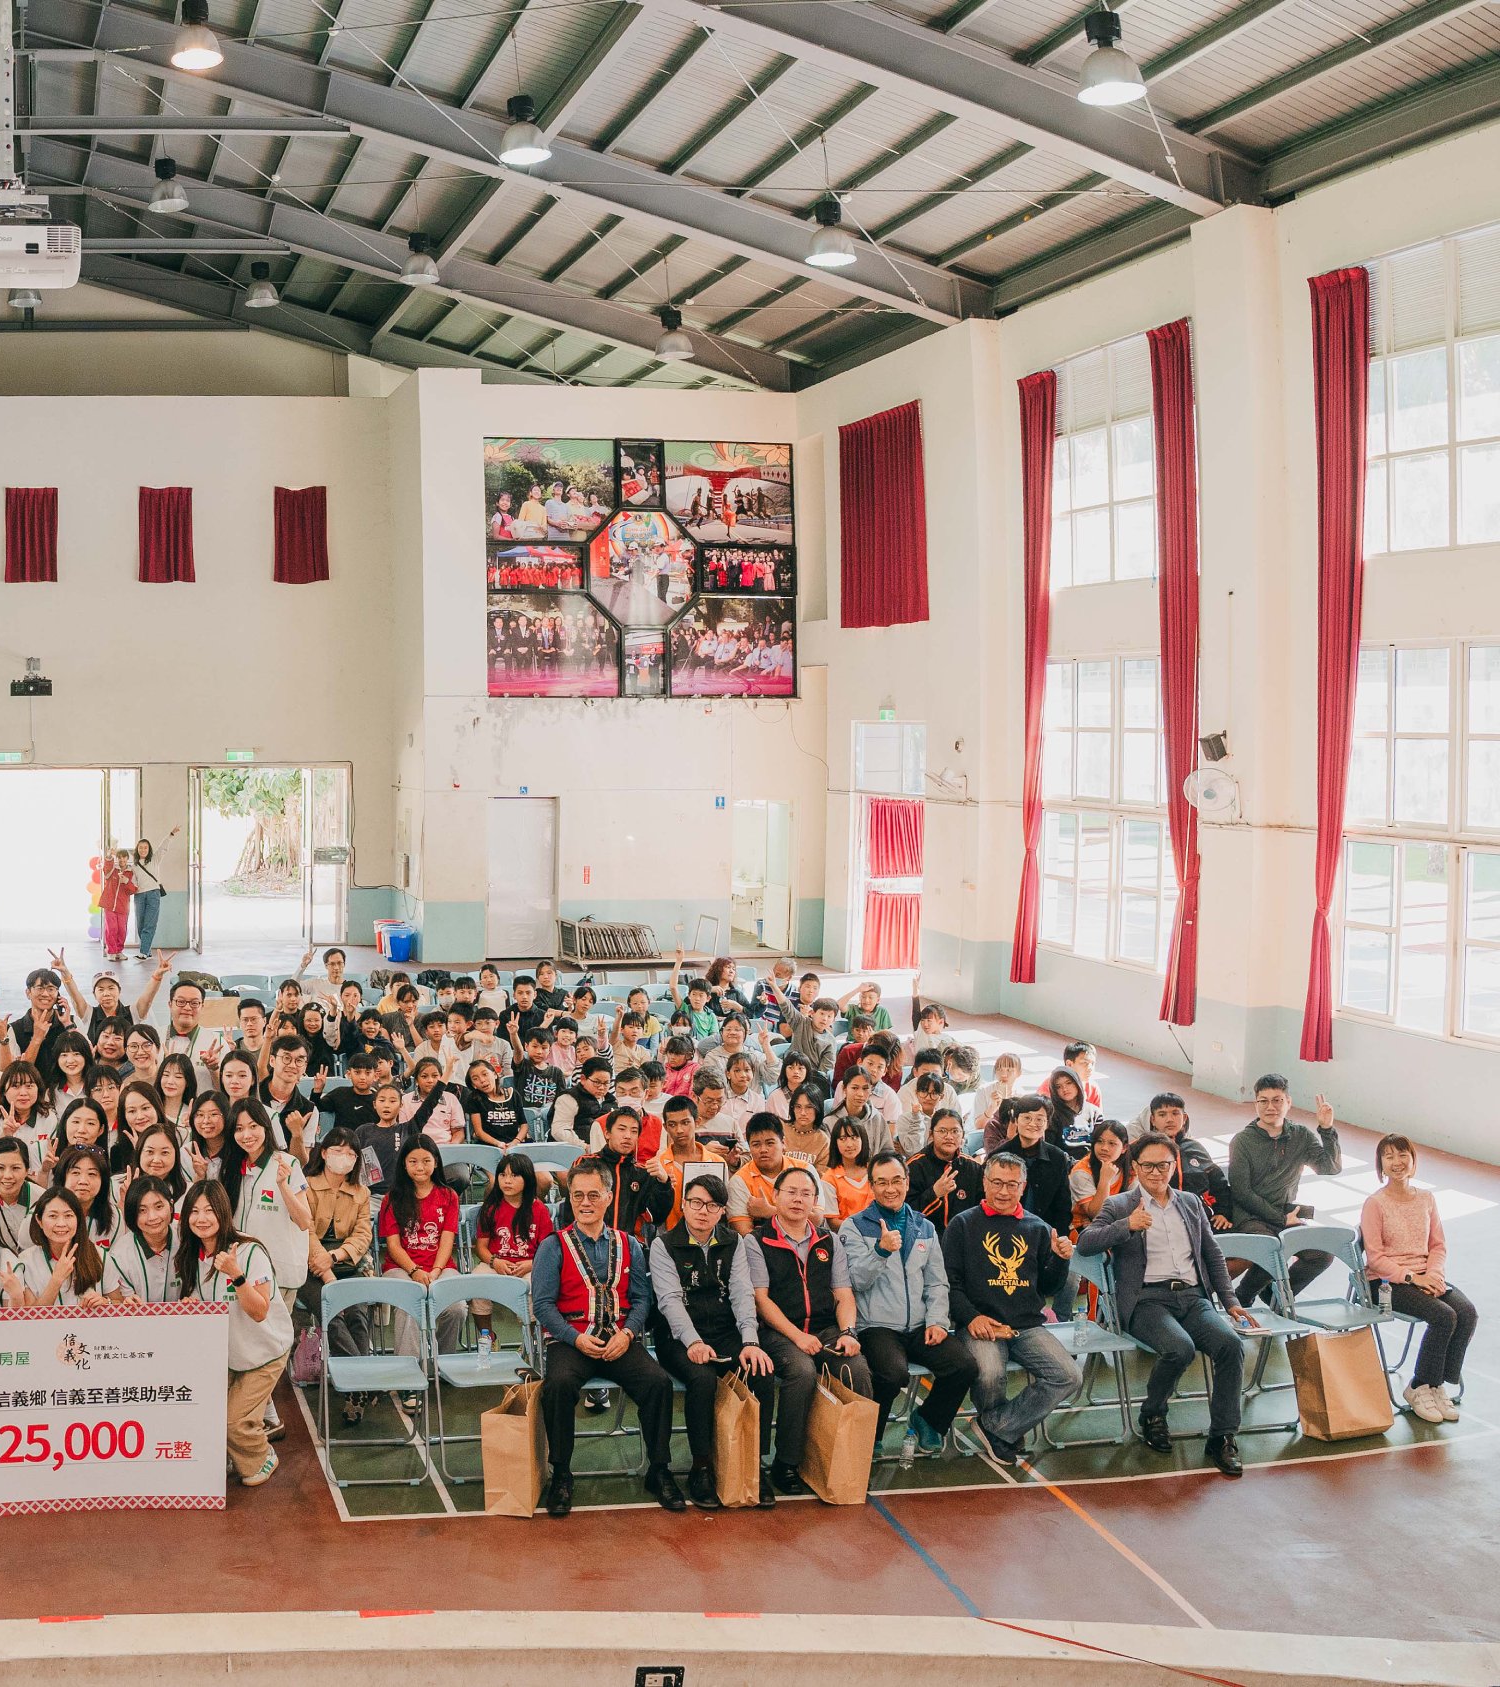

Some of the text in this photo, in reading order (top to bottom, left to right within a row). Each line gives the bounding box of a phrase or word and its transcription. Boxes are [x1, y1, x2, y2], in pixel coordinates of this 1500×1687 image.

[487, 1110, 516, 1120] SENSE
[987, 1279, 1030, 1288] TAKISTALAN
[93, 1351, 155, 1360] 信義文化基金會
[50, 1384, 193, 1406] 信義至善獎助學金
[155, 1440, 193, 1459] 元整
